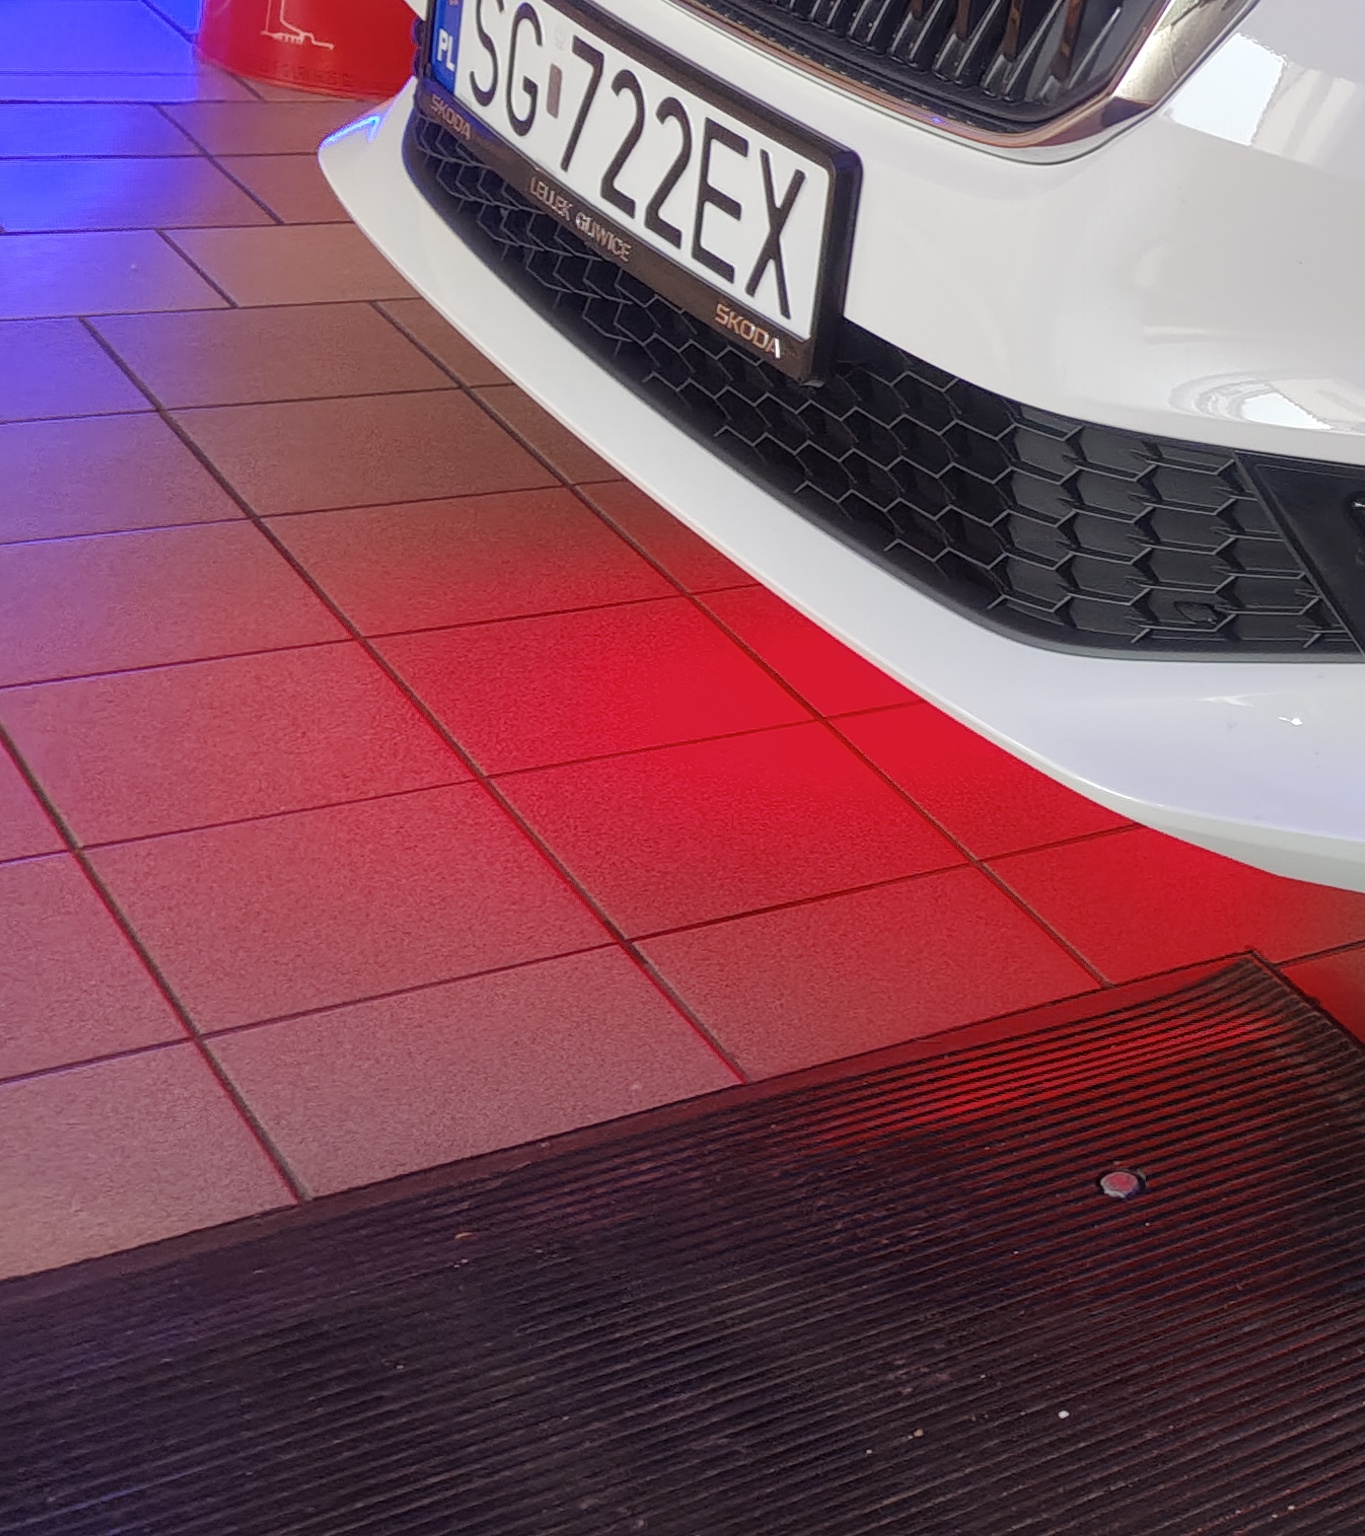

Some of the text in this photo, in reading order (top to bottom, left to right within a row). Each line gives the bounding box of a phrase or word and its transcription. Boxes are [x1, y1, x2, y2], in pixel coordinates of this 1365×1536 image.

[436, 29, 455, 72] PL
[561, 35, 806, 320] 722EX
[576, 211, 632, 262] GLIWICE
